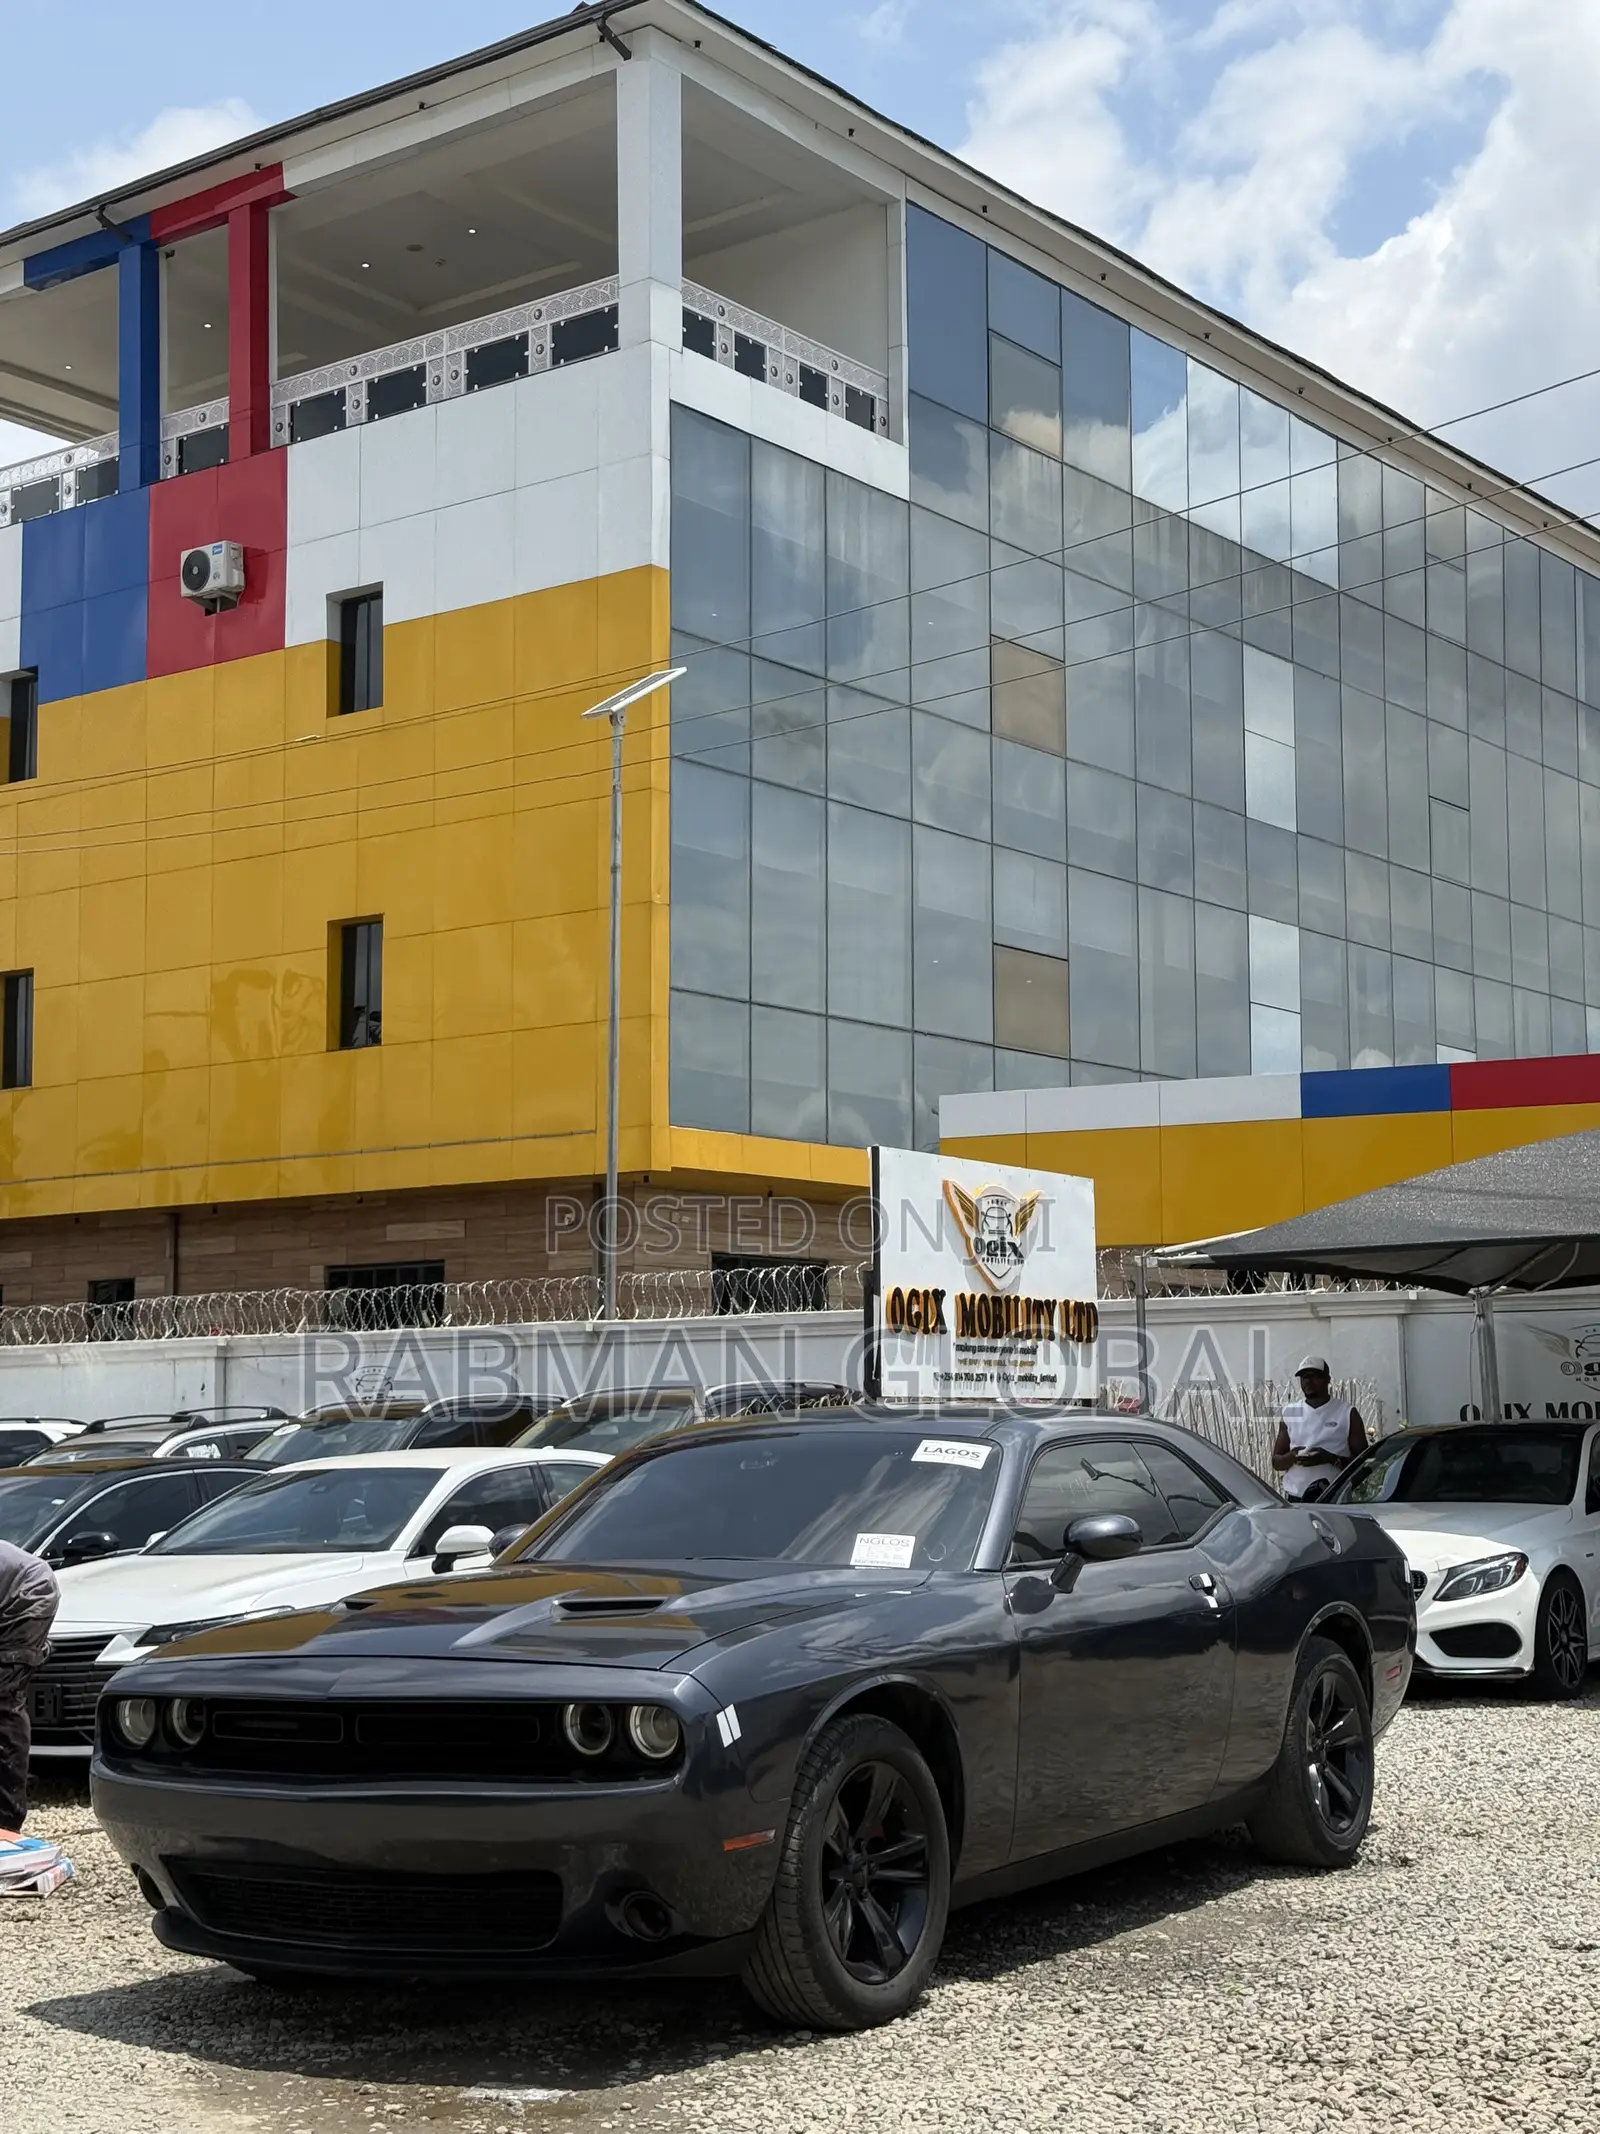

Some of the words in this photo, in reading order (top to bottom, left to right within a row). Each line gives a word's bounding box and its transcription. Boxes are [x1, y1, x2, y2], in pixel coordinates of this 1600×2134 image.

[886, 1286, 948, 1335] OGIX
[954, 1292, 1057, 1341] MOBILITY
[1059, 1299, 1099, 1343] LTD
[1460, 1402, 1532, 1421] OIX
[923, 1446, 981, 1459] LAGOS
